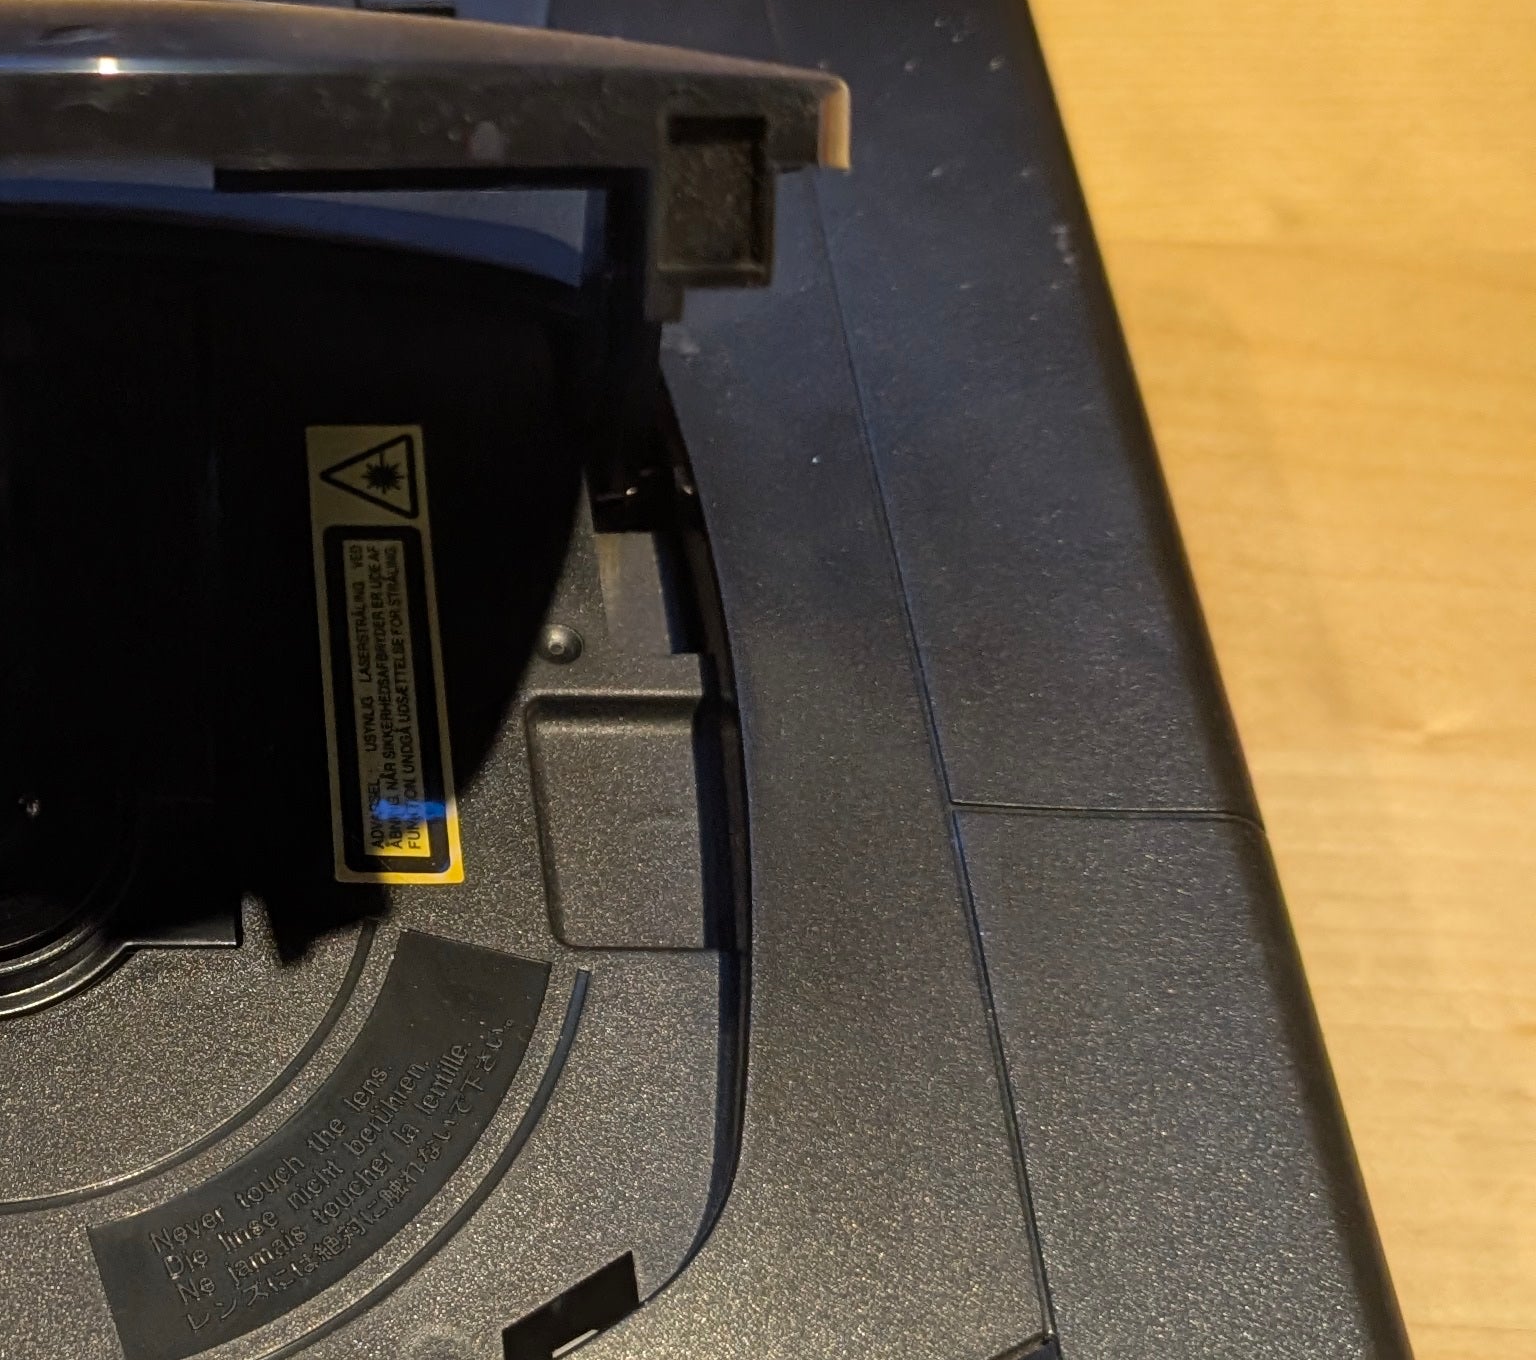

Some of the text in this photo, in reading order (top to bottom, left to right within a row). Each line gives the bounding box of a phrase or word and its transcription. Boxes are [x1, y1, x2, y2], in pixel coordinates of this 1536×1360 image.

[149, 1066, 392, 1254] Never touch the lens.
[165, 1061, 429, 1280] Die linse nicht berühren.
[175, 1042, 472, 1306] Ne jamais toucher la lentille.
